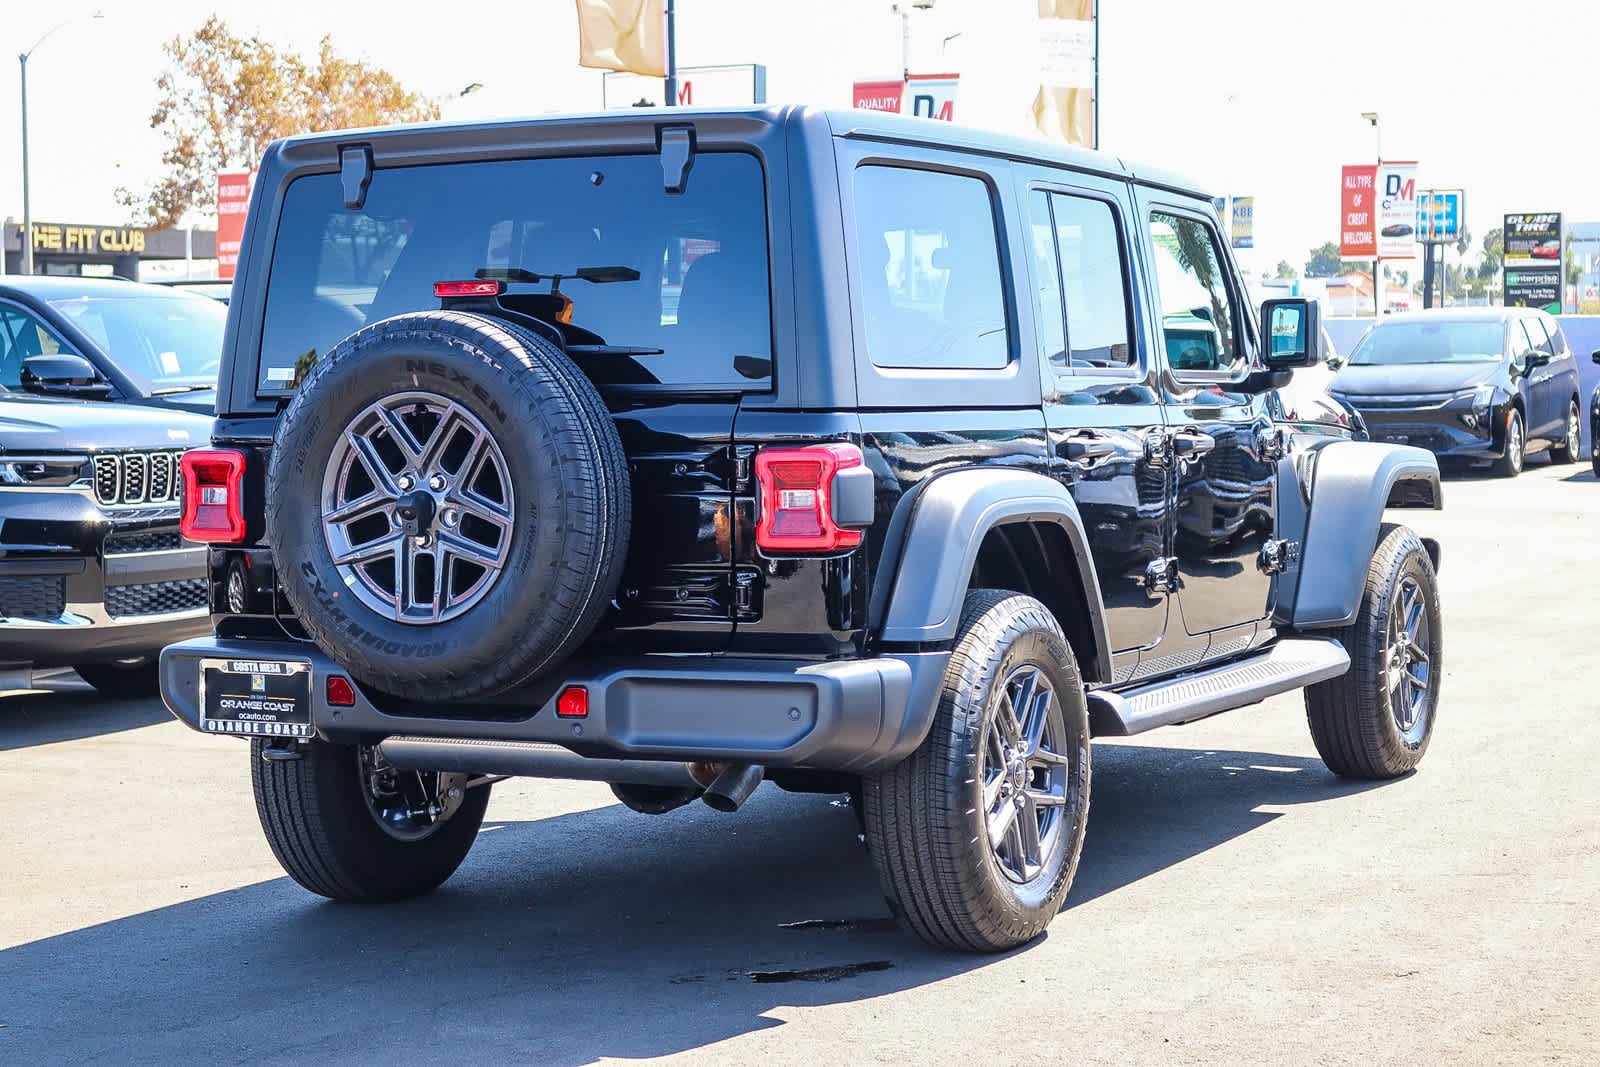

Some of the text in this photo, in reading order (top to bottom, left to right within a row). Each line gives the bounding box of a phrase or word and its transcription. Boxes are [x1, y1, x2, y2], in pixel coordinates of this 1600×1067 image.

[857, 97, 899, 110] QUALITY
[1346, 175, 1372, 187] ALL TYPE
[1353, 194, 1362, 206] OF
[1233, 207, 1253, 217] KBB
[1347, 213, 1368, 225] CREDIT
[65, 227, 97, 250] FIT
[99, 229, 145, 252] CLUB
[1343, 232, 1373, 244] WELCOME
[405, 359, 508, 424] NEXEN
[233, 662, 281, 673] COSTA MESA
[220, 700, 296, 712] ORANGE COAST
[238, 712, 277, 722] ocauto.com
[208, 720, 308, 735] ORANGE COAST
